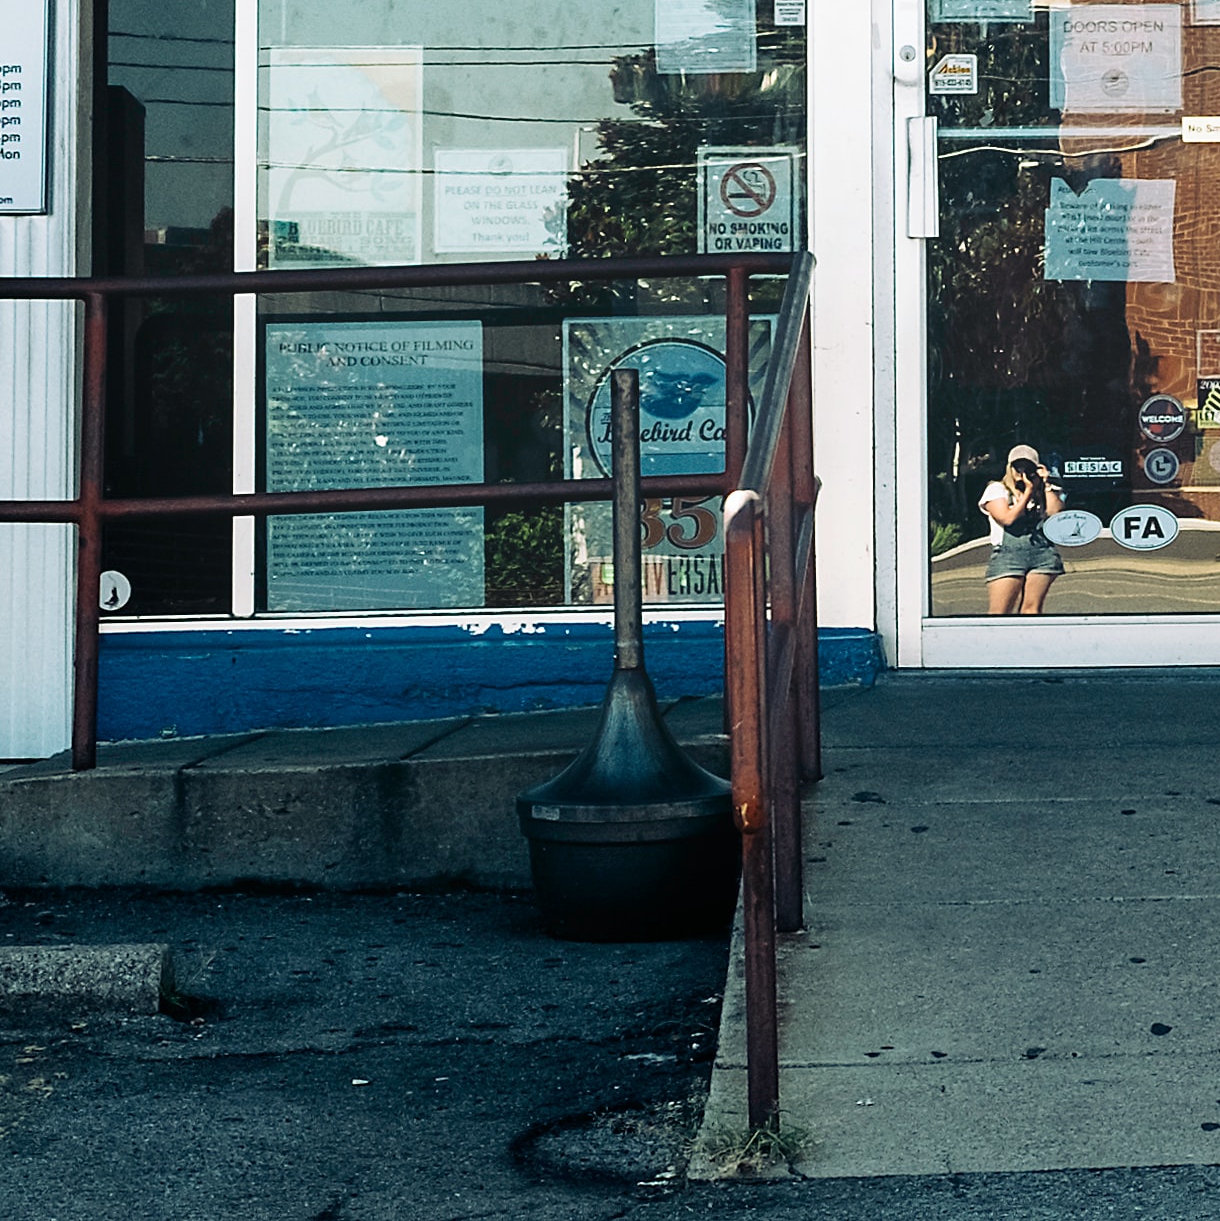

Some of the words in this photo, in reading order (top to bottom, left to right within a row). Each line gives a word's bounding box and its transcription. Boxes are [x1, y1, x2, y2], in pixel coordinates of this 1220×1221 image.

[1063, 21, 1118, 33] DOORS
[1121, 20, 1164, 32] OPEN
[1080, 42, 1097, 53] AT
[1102, 41, 1153, 54] 5:00PM
[0, 64, 21, 76] pm
[0, 81, 21, 93] pm
[0, 98, 21, 110] pm
[0, 116, 21, 128] pm
[0, 133, 21, 145] pm
[445, 186, 480, 195] PLEASE
[485, 186, 501, 195] DO
[505, 186, 526, 195] NOT
[463, 201, 480, 210] ON
[485, 201, 502, 210] THE
[506, 200, 538, 210] GLASS
[709, 223, 727, 234] NO
[730, 222, 788, 234] SMOKING
[715, 238, 732, 249] OR
[736, 238, 782, 249] VAPING
[279, 342, 330, 353] PUBLIC
[335, 341, 387, 352] NOTICE
[391, 341, 409, 351] OF
[414, 340, 473, 351] FILMING
[326, 357, 357, 367] AND
[360, 355, 428, 366] CONSENT
[1142, 415, 1183, 423] WELCOME
[1065, 461, 1122, 473] SESAC
[1124, 516, 1165, 539] FA
